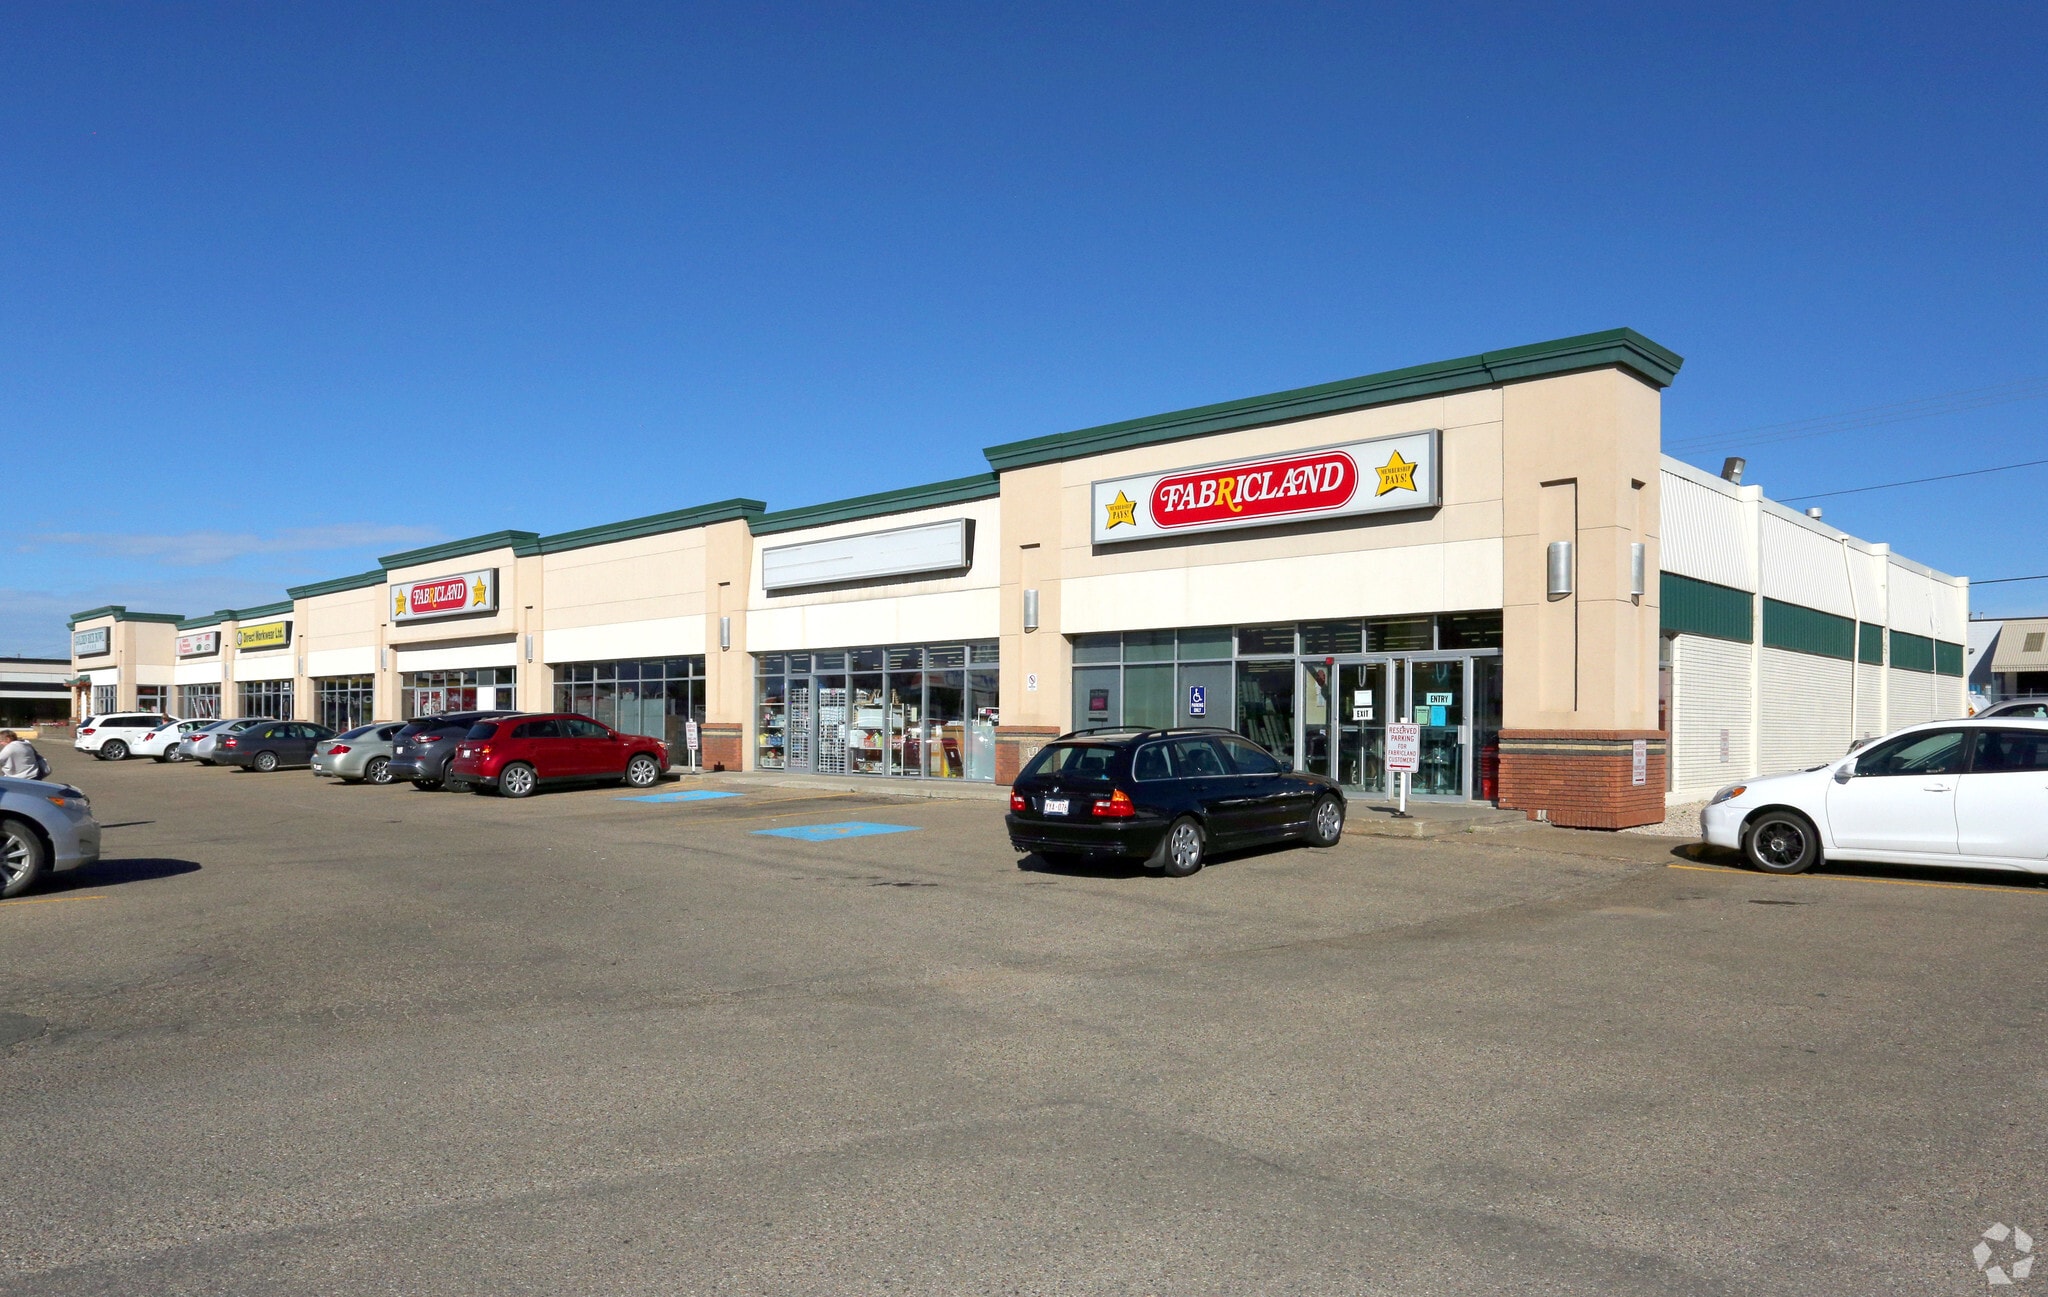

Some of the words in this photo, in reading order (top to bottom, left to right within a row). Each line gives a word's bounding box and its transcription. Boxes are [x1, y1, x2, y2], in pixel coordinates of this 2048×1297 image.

[1381, 465, 1411, 474] MEMBERSHIP
[1385, 473, 1407, 485] PAYS!
[1160, 462, 1344, 512] FABRICLAND
[1112, 510, 1129, 520] PAYS!
[413, 583, 464, 608] FABRICLAND
[243, 633, 256, 643] Direct
[275, 627, 284, 639] Ltd.
[1430, 695, 1449, 703] ENTRY
[1356, 709, 1369, 718] EXIT
[1388, 726, 1417, 735] RESERVED
[1390, 734, 1415, 743] PARKING
[1388, 749, 1417, 757] FABRICLAND
[1388, 756, 1416, 764] CUSTOMERS
